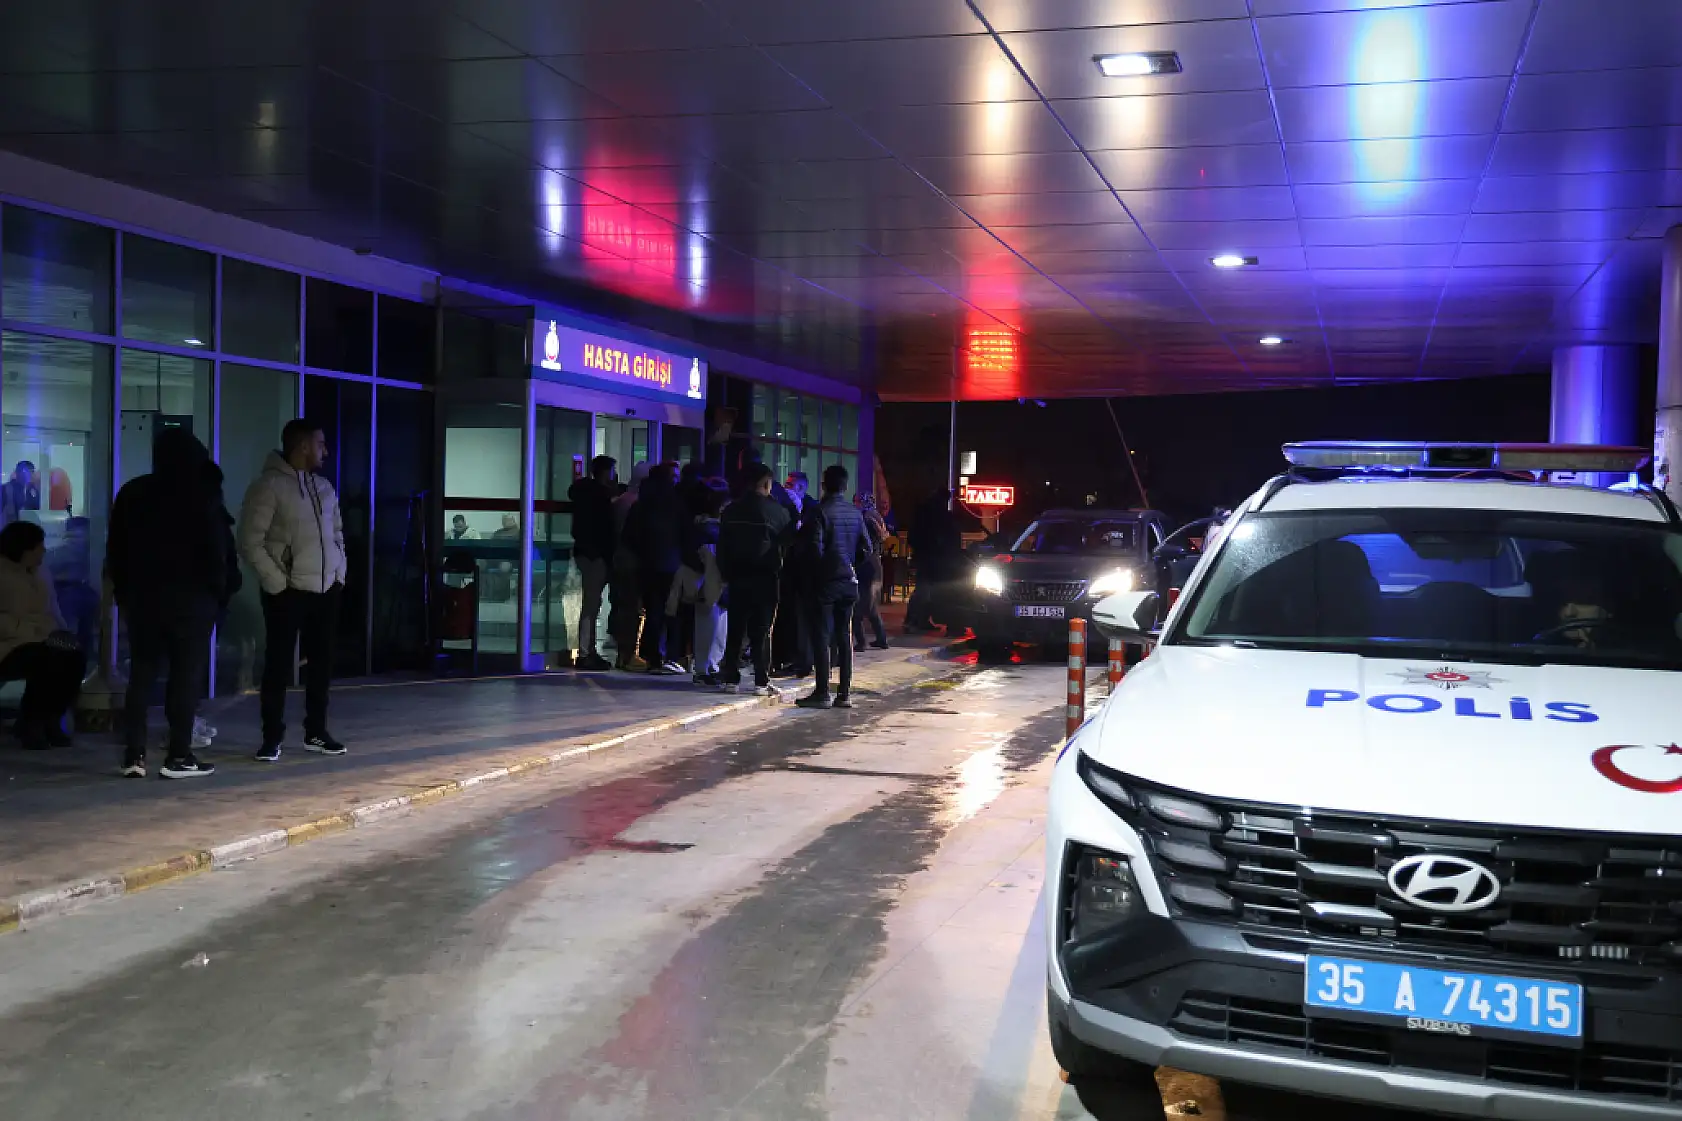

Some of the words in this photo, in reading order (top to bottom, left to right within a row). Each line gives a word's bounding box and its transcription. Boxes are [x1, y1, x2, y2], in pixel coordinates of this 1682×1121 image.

[584, 343, 630, 375] HASTA
[633, 352, 672, 388] GİRİŞİ
[967, 488, 1010, 503] TAKİP
[1305, 688, 1600, 723] POLİS
[1317, 962, 1366, 1005] 35
[1393, 970, 1417, 1013] A
[1441, 974, 1571, 1030] 74315
